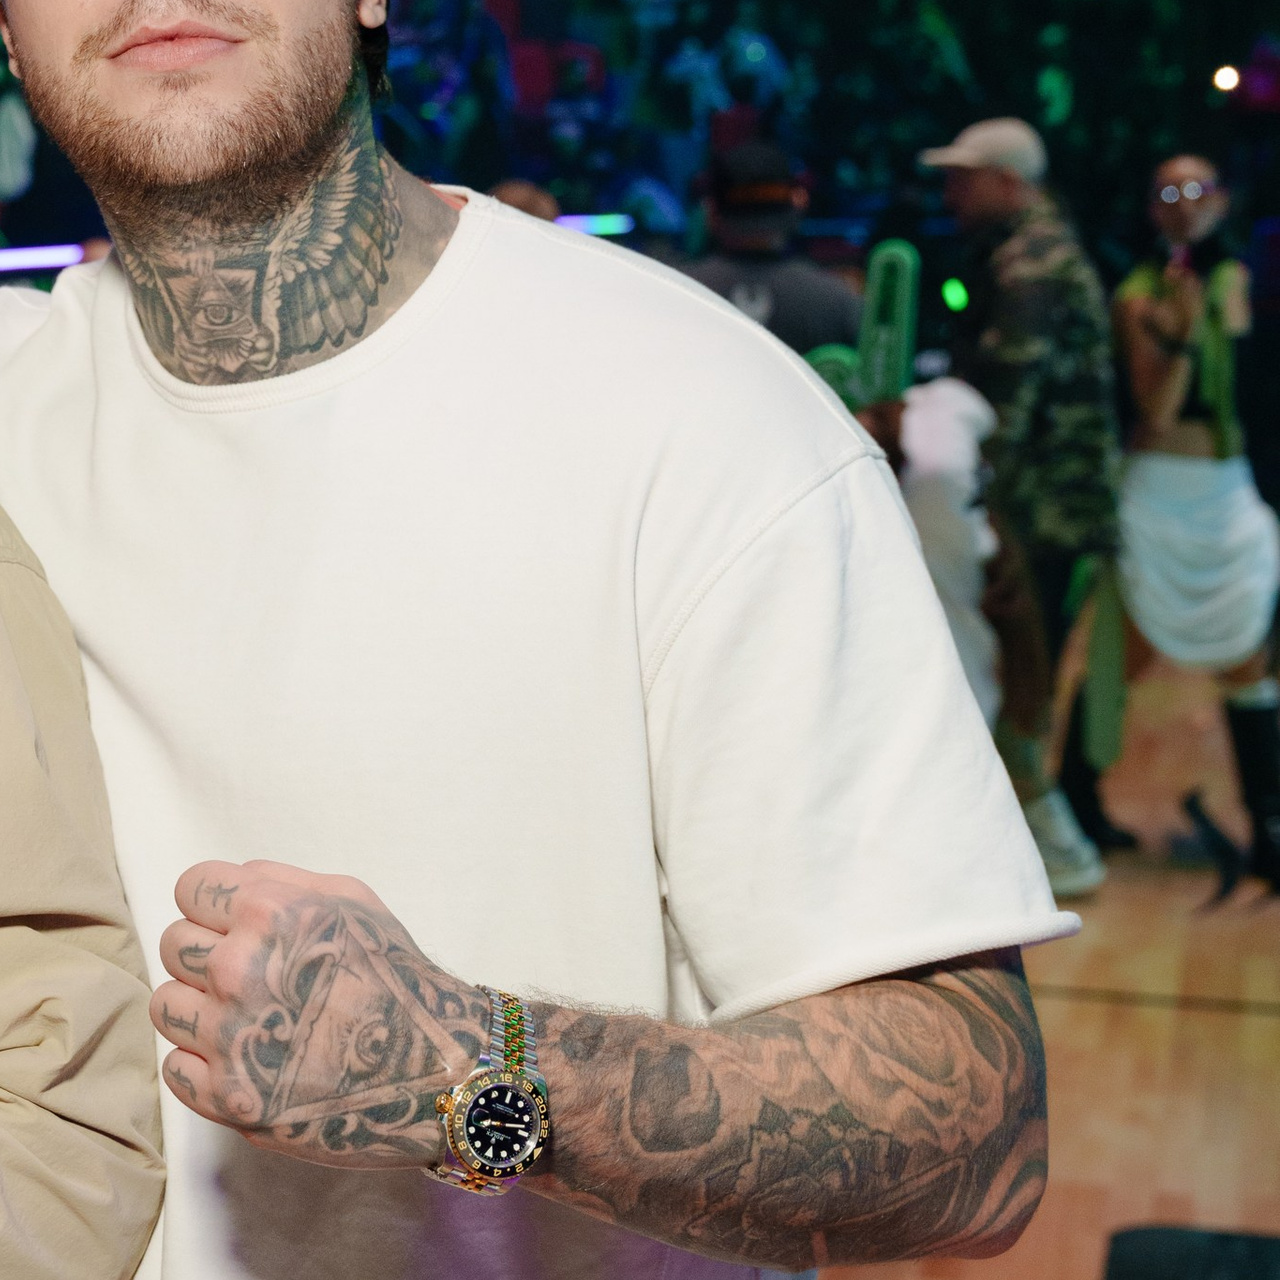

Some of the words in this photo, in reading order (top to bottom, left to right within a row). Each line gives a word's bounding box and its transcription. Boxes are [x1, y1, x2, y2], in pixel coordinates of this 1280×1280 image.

[477, 1076, 491, 1088] 14
[500, 1073, 513, 1083] 16
[521, 1080, 534, 1093] 18
[461, 1090, 474, 1105] 12
[535, 1095, 547, 1114] 20
[454, 1114, 464, 1129] 10
[540, 1119, 549, 1138] 22
[458, 1140, 468, 1151] 8
[472, 1159, 482, 1170] 6
[515, 1162, 524, 1173] 2
[493, 1168, 502, 1177] 4
